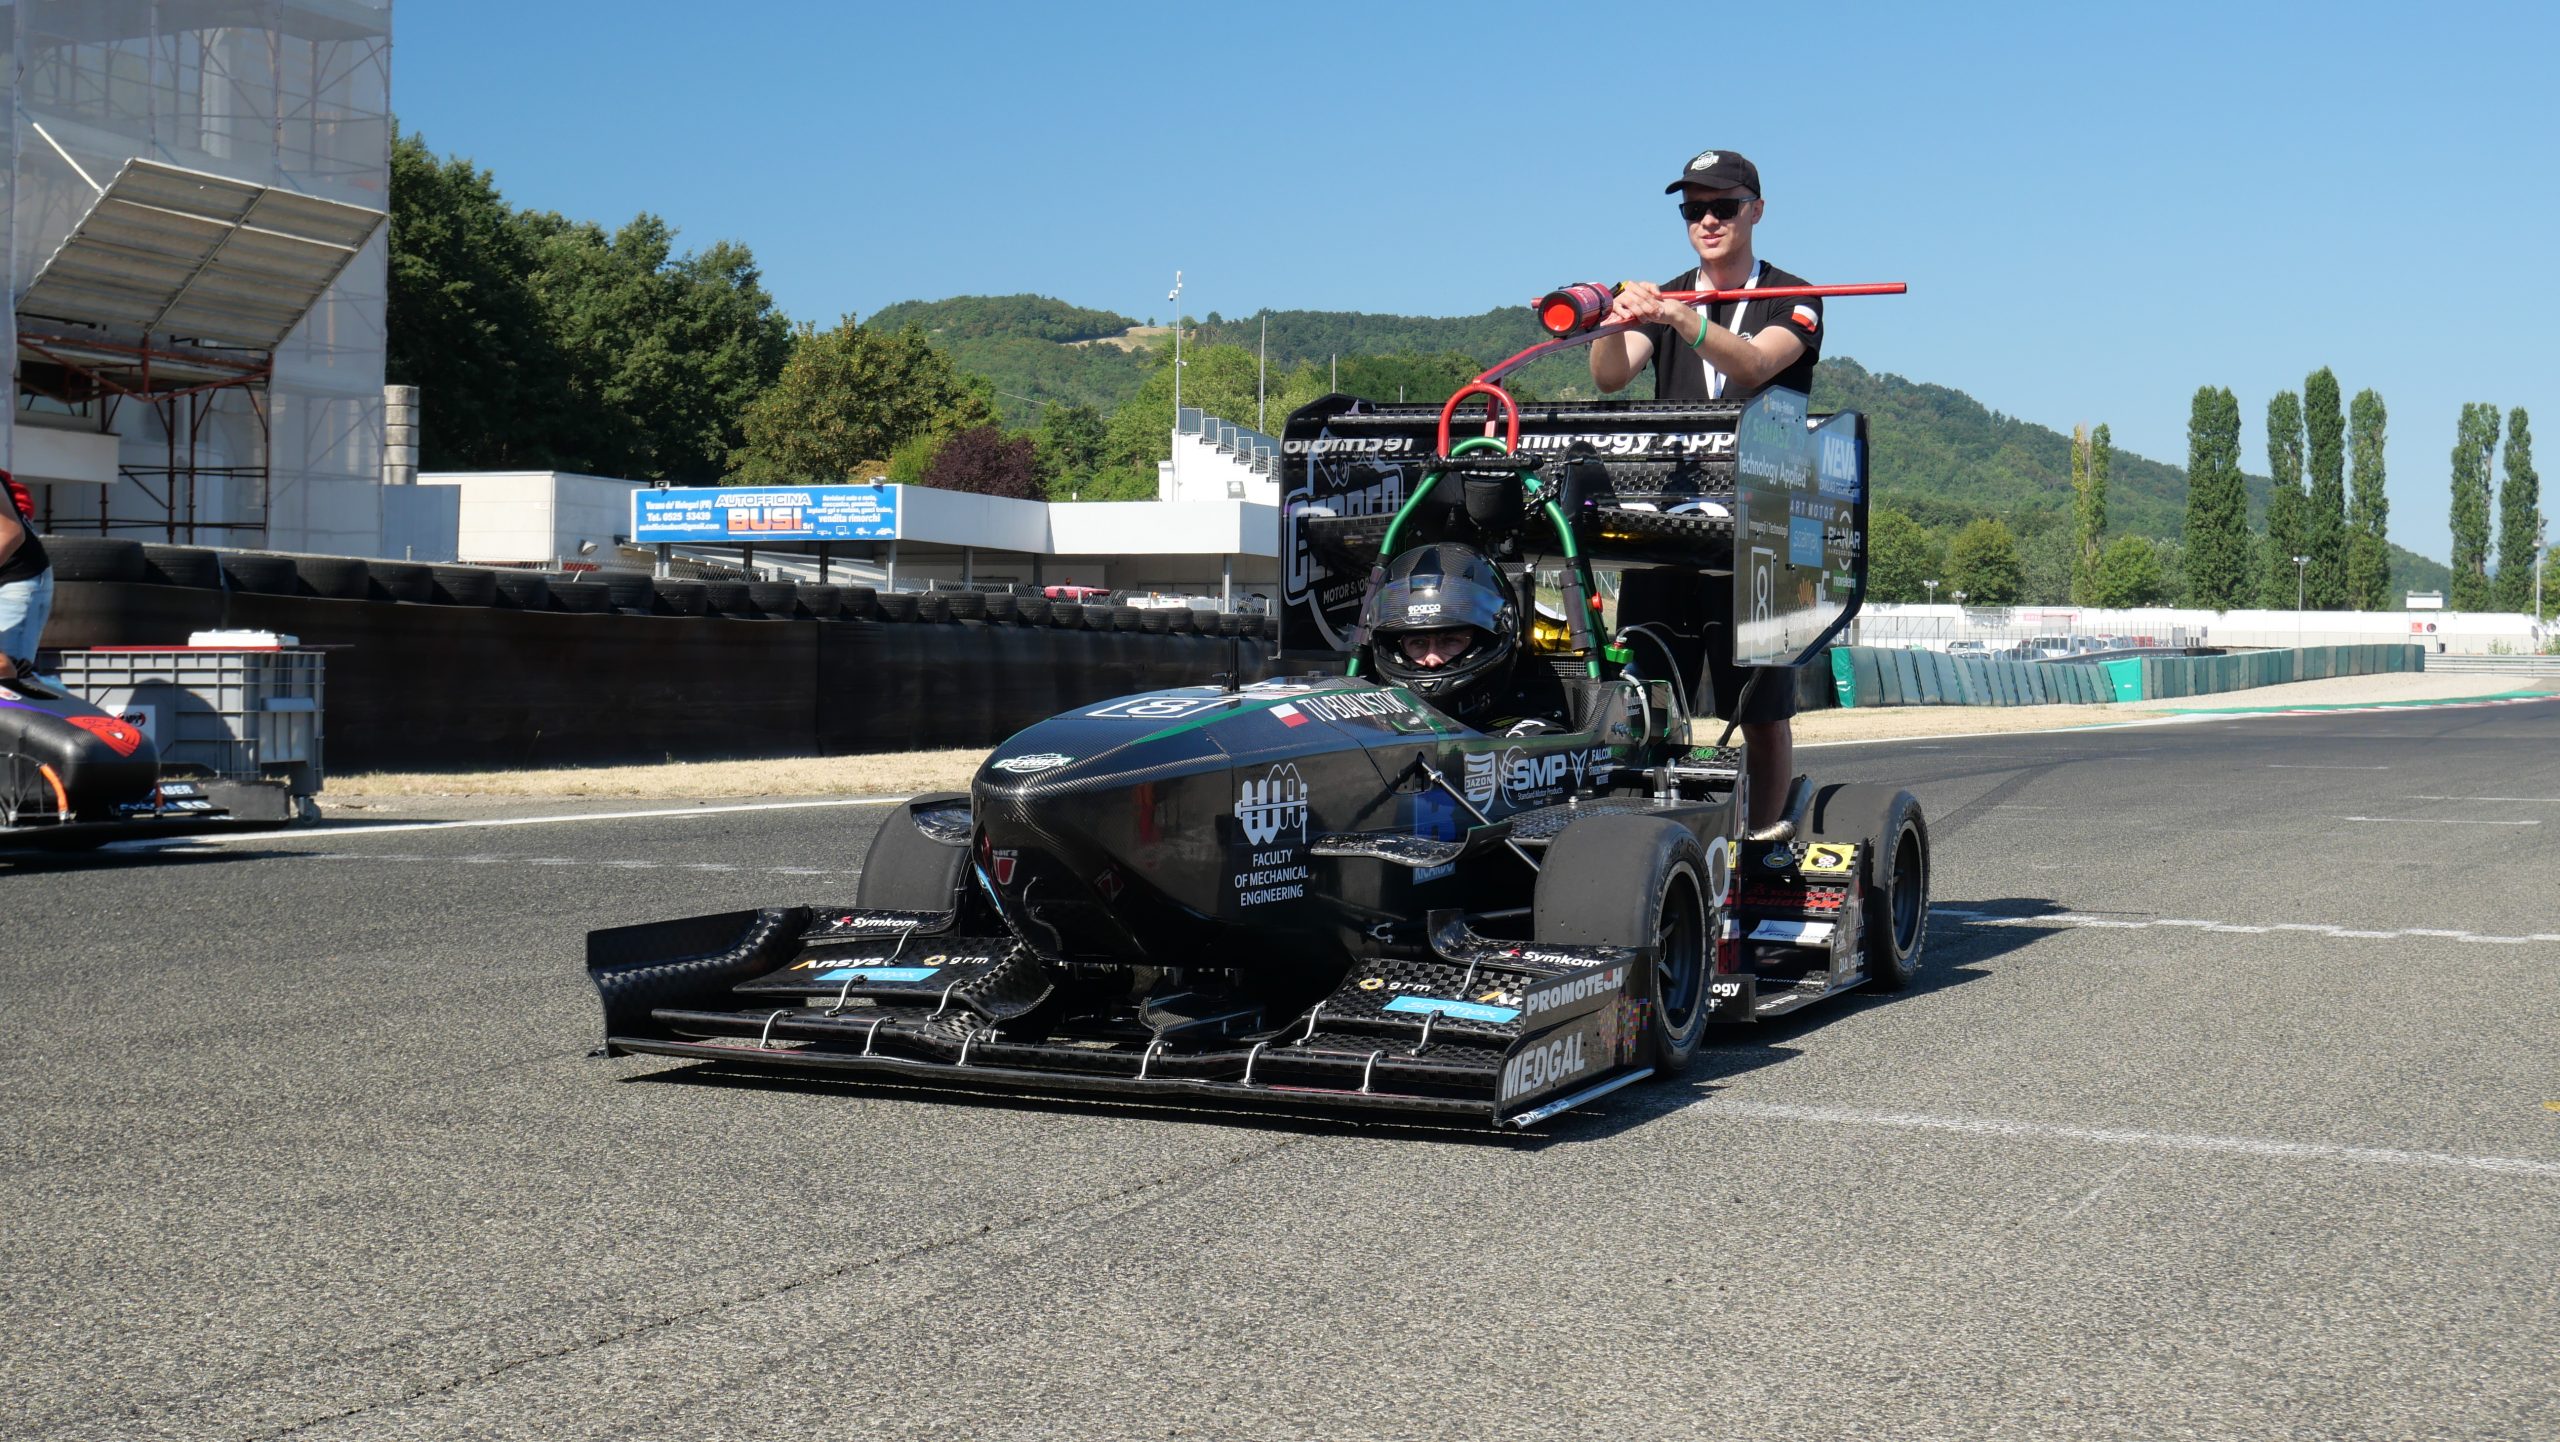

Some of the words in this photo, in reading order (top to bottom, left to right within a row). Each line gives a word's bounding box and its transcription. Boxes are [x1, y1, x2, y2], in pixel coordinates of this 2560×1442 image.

[1822, 436, 1858, 482] NEVA
[1738, 452, 1778, 485] Technology
[1780, 462, 1806, 489] Applied
[714, 493, 813, 508] AUTOFFICINA
[1790, 500, 1806, 514] ART
[1808, 503, 1834, 520] MOTOR
[663, 512, 682, 521] 0525
[727, 508, 801, 531] BUSI
[819, 514, 847, 523] vendita
[849, 514, 881, 523] rimorchi
[1323, 584, 1349, 606] MOTOR
[1408, 603, 1441, 615] sparco
[1296, 697, 1337, 722] TU
[1513, 754, 1567, 791] SMP
[1252, 849, 1293, 867] FACULTY
[1234, 874, 1248, 889] OF
[1249, 865, 1309, 887] MECHANICAL
[1240, 884, 1304, 907] ENGINEERING
[851, 918, 918, 928] Symkom
[790, 956, 884, 970] Ansys
[949, 955, 989, 965] grm
[1388, 980, 1431, 992] grm
[1527, 967, 1623, 1017] PROMOTECH
[1501, 1031, 1586, 1101] MEDGAL
